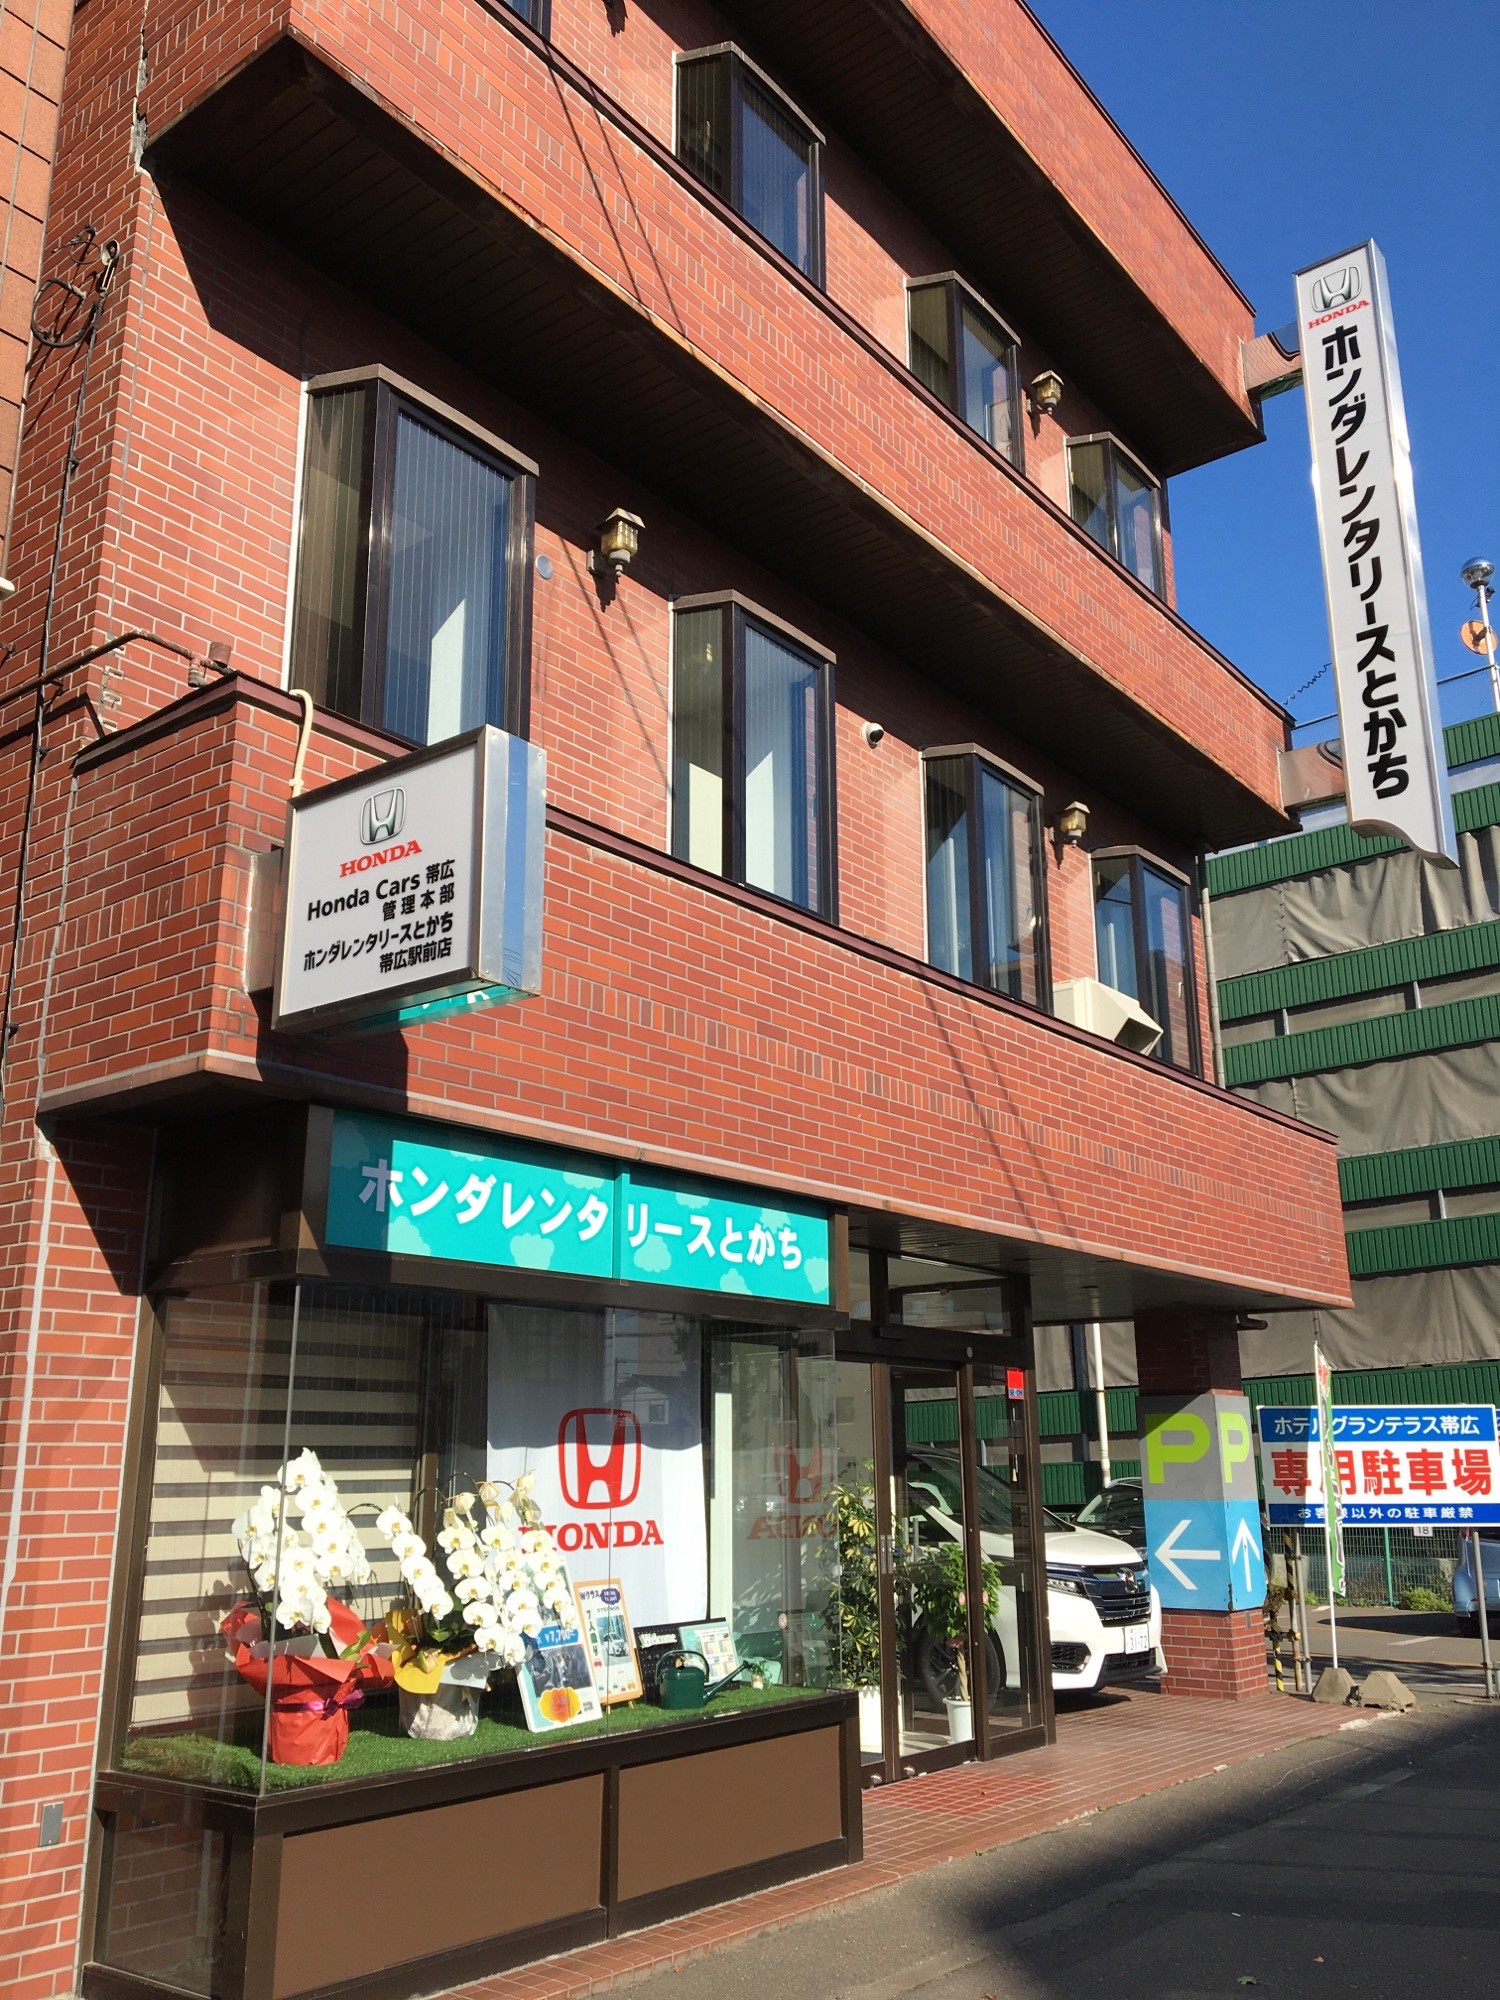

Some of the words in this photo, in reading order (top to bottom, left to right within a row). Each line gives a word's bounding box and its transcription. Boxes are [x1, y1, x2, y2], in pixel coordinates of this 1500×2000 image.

[1308, 299, 1370, 329] HONDA
[1321, 325, 1410, 800] ホンダレンタリースとかち
[339, 840, 422, 878] HONDA
[307, 887, 369, 921] Honda
[375, 871, 421, 901] Cars
[425, 859, 455, 883] 帯広
[382, 882, 455, 922] 管理本部
[303, 911, 453, 972] ホンダレンタリースとかち
[379, 937, 452, 974] 帯広駅前店
[1144, 1412, 1211, 1483] P
[1219, 1411, 1250, 1483] P
[1270, 1448, 1492, 1496] 専用駐車場
[519, 1519, 664, 1552] ONDA
[1417, 1526, 1430, 1535] 18
